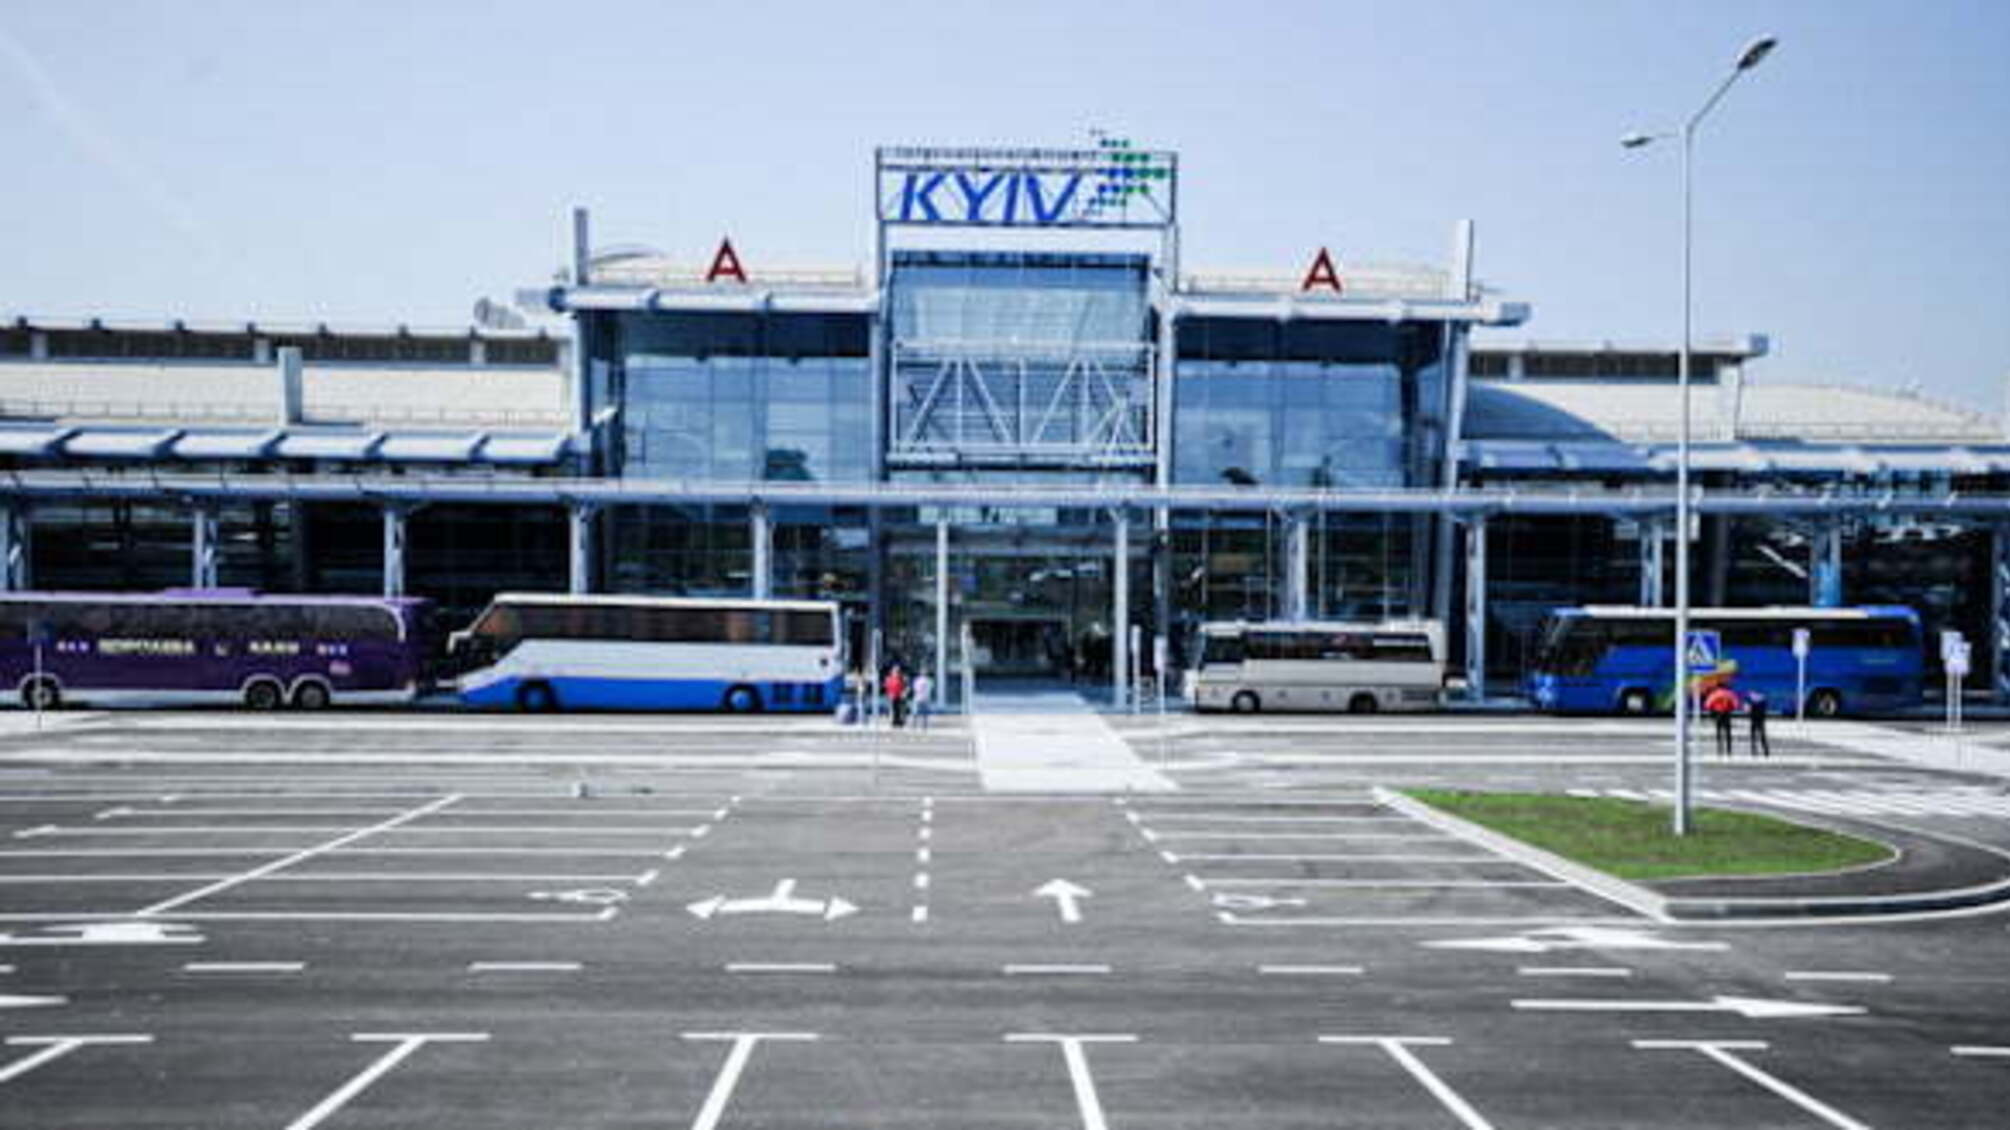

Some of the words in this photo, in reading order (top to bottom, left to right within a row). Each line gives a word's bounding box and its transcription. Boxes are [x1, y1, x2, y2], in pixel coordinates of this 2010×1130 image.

[900, 172, 1082, 221] KYIV
[707, 237, 746, 283] A
[1302, 247, 1342, 292] A
